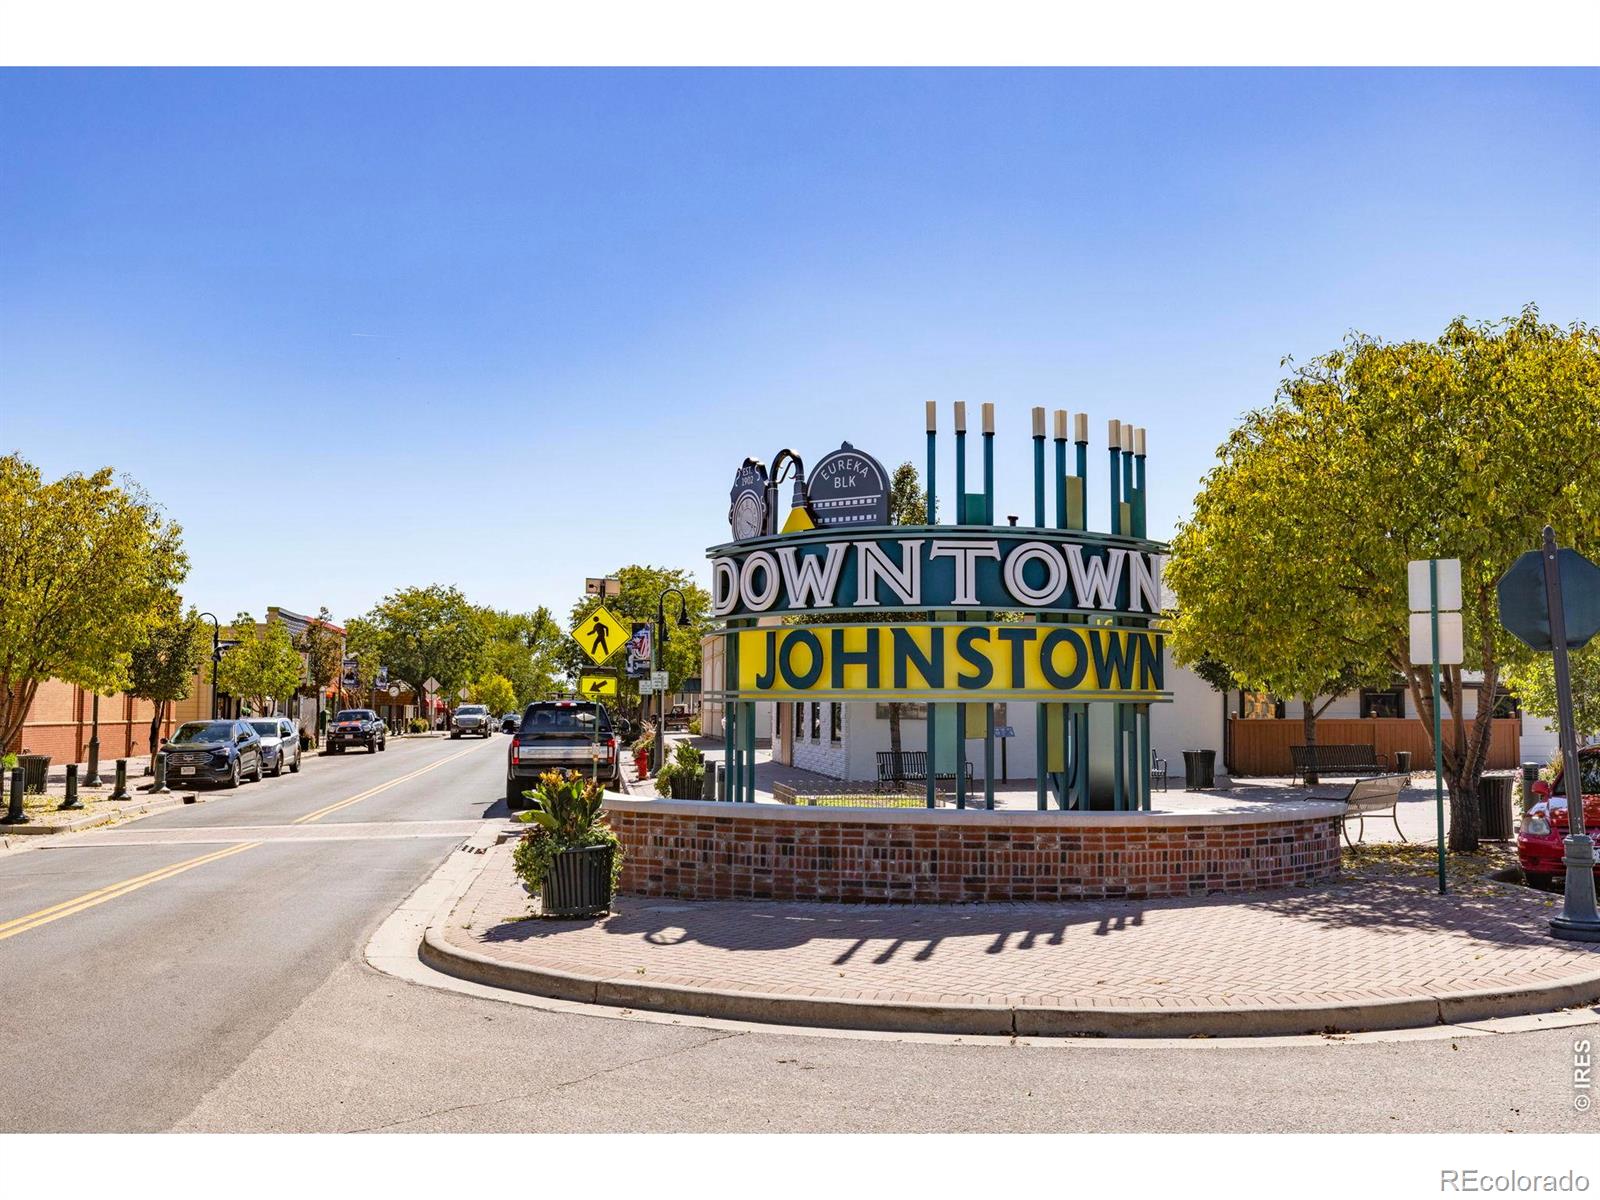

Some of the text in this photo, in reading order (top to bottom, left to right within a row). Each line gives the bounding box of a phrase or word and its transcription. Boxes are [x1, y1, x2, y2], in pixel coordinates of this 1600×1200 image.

[821, 459, 868, 480] EUREKA
[834, 475, 856, 489] BLK
[712, 540, 1161, 615] DOWNTOWN
[756, 627, 1164, 690] JOHNSTOWN
